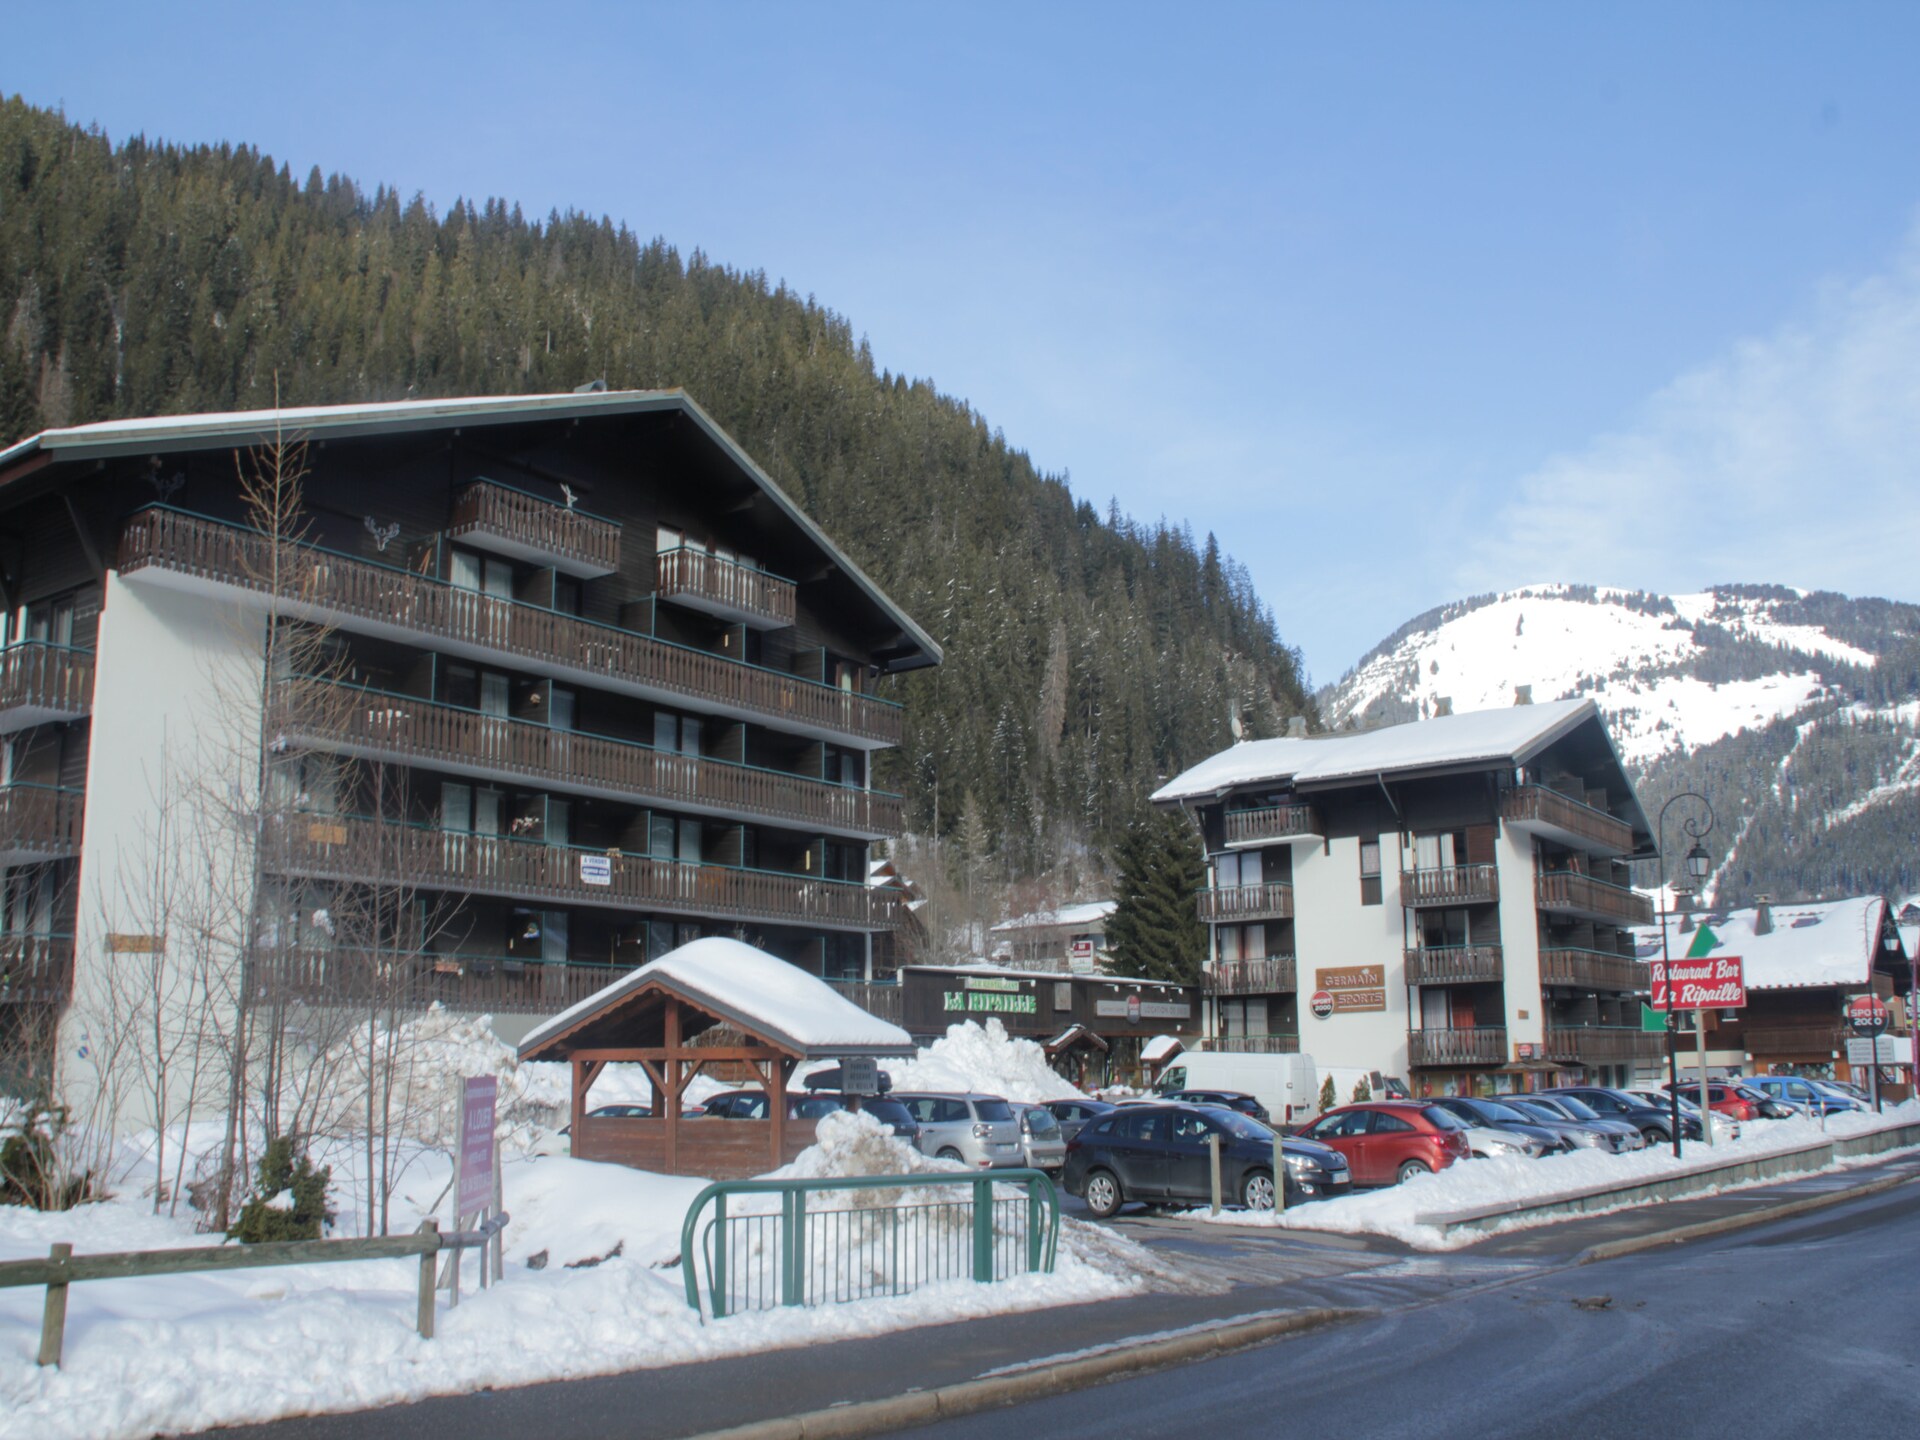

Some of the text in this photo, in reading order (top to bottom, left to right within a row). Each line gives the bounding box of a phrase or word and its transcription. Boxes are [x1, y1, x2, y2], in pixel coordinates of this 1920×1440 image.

[1716, 960, 1740, 979] Bar
[1325, 974, 1378, 986] GERMAIN
[944, 991, 1036, 1013] LA RIPAILLE
[1338, 992, 1383, 1004] SPORTS
[1681, 983, 1741, 1007] Ripaille
[1850, 1008, 1885, 1017] SPORT
